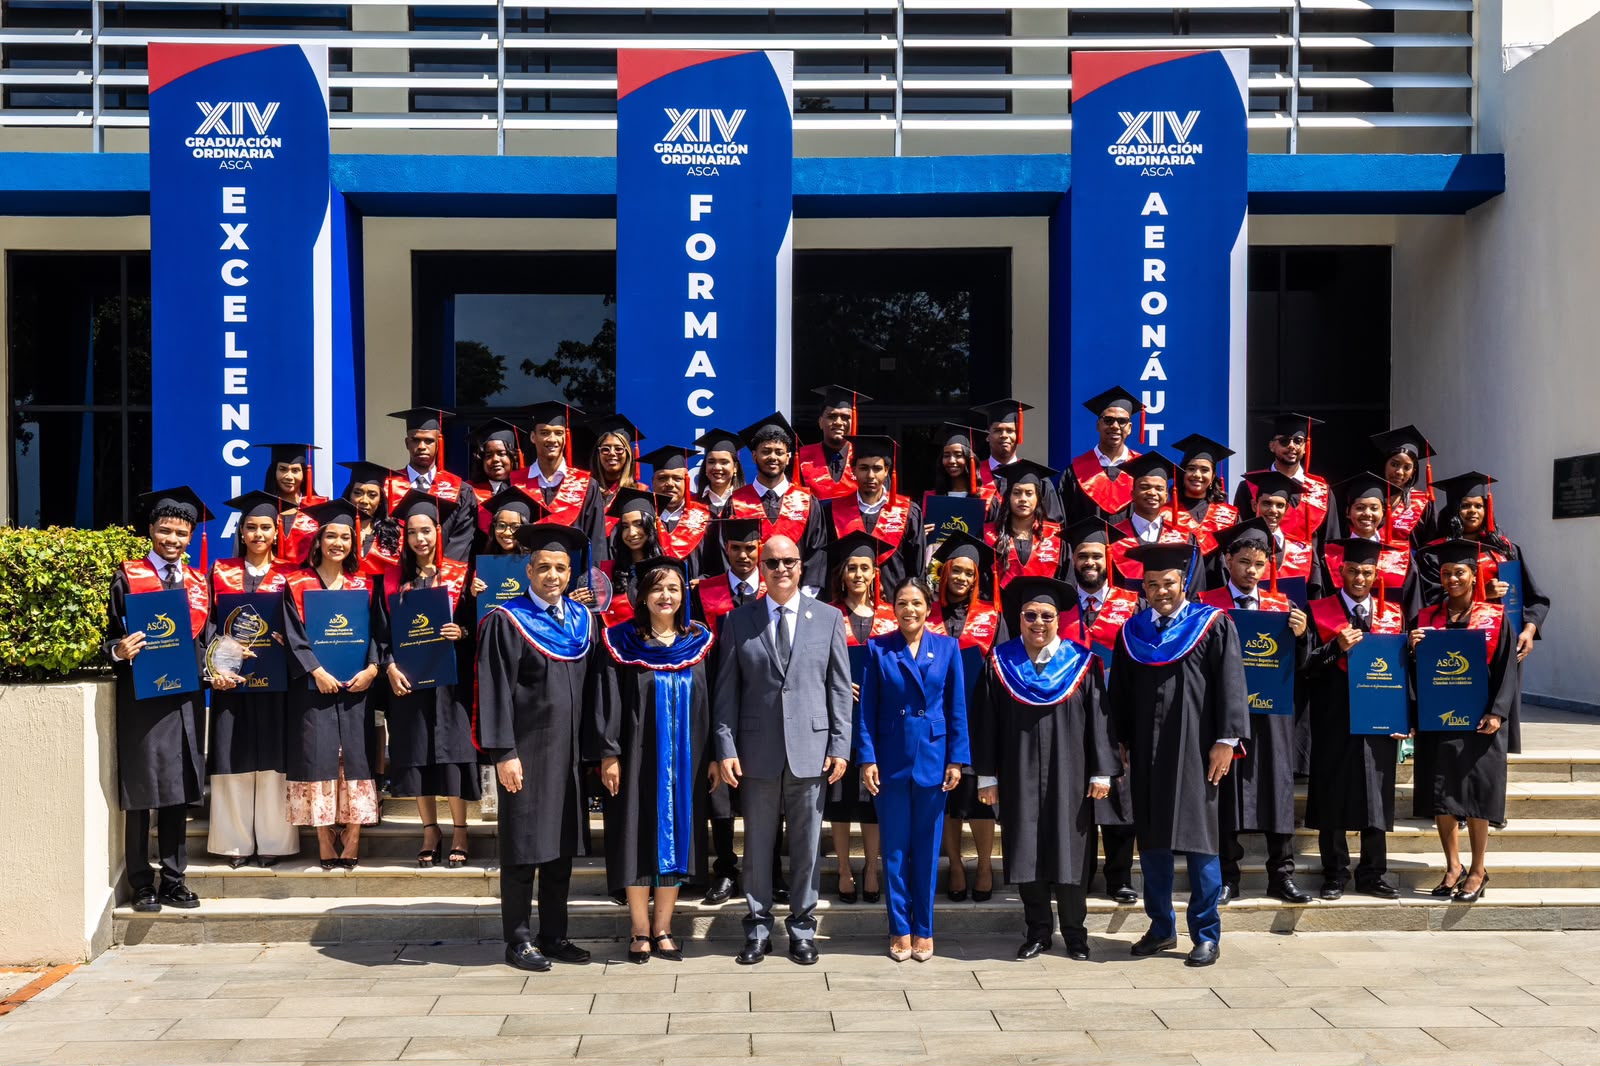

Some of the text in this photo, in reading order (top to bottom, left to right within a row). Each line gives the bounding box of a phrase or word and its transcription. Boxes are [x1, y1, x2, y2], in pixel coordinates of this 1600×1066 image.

[195, 101, 281, 135] XIV
[662, 108, 747, 142] XIV
[1115, 110, 1201, 144] XIV
[185, 135, 282, 148] GRADUACIÓN
[192, 148, 274, 159] ORDINARIA
[653, 141, 748, 155] GRADUACIÓN
[1107, 142, 1203, 155] GRADUACIÓN
[219, 160, 253, 170] ASCA
[661, 154, 741, 166] ORDINARIA
[1114, 154, 1195, 166] ORDINARIA
[686, 166, 719, 177] ASCA
[1140, 166, 1174, 177] ASCA
[941, 522, 960, 530] ASCA
[146, 620, 168, 631] ASCA
[1245, 639, 1269, 649] ASCA
[1436, 658, 1460, 667] ASCA
[163, 679, 181, 688] IDAC
[249, 677, 268, 686] IDAC
[1253, 699, 1273, 707] IDAC
[1448, 716, 1469, 724] IDAC
